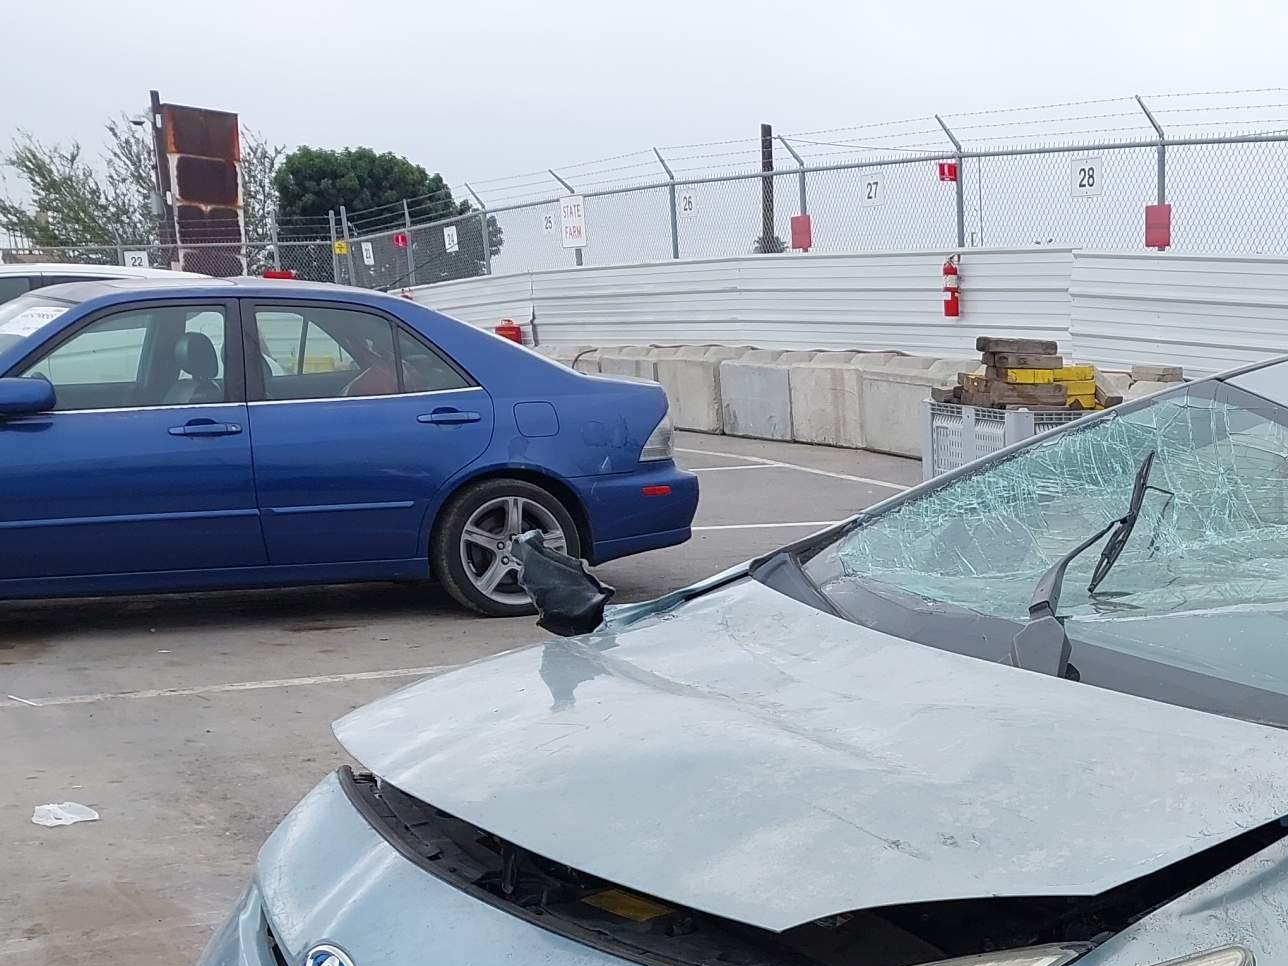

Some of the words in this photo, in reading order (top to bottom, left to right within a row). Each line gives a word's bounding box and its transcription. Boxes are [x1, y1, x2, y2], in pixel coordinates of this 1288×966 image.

[1078, 166, 1096, 188] 28
[866, 181, 879, 200] 27
[562, 203, 582, 219] STATE
[683, 195, 693, 212] 26
[544, 215, 553, 230] 25
[564, 225, 582, 240] FARM
[130, 256, 144, 267] 22
